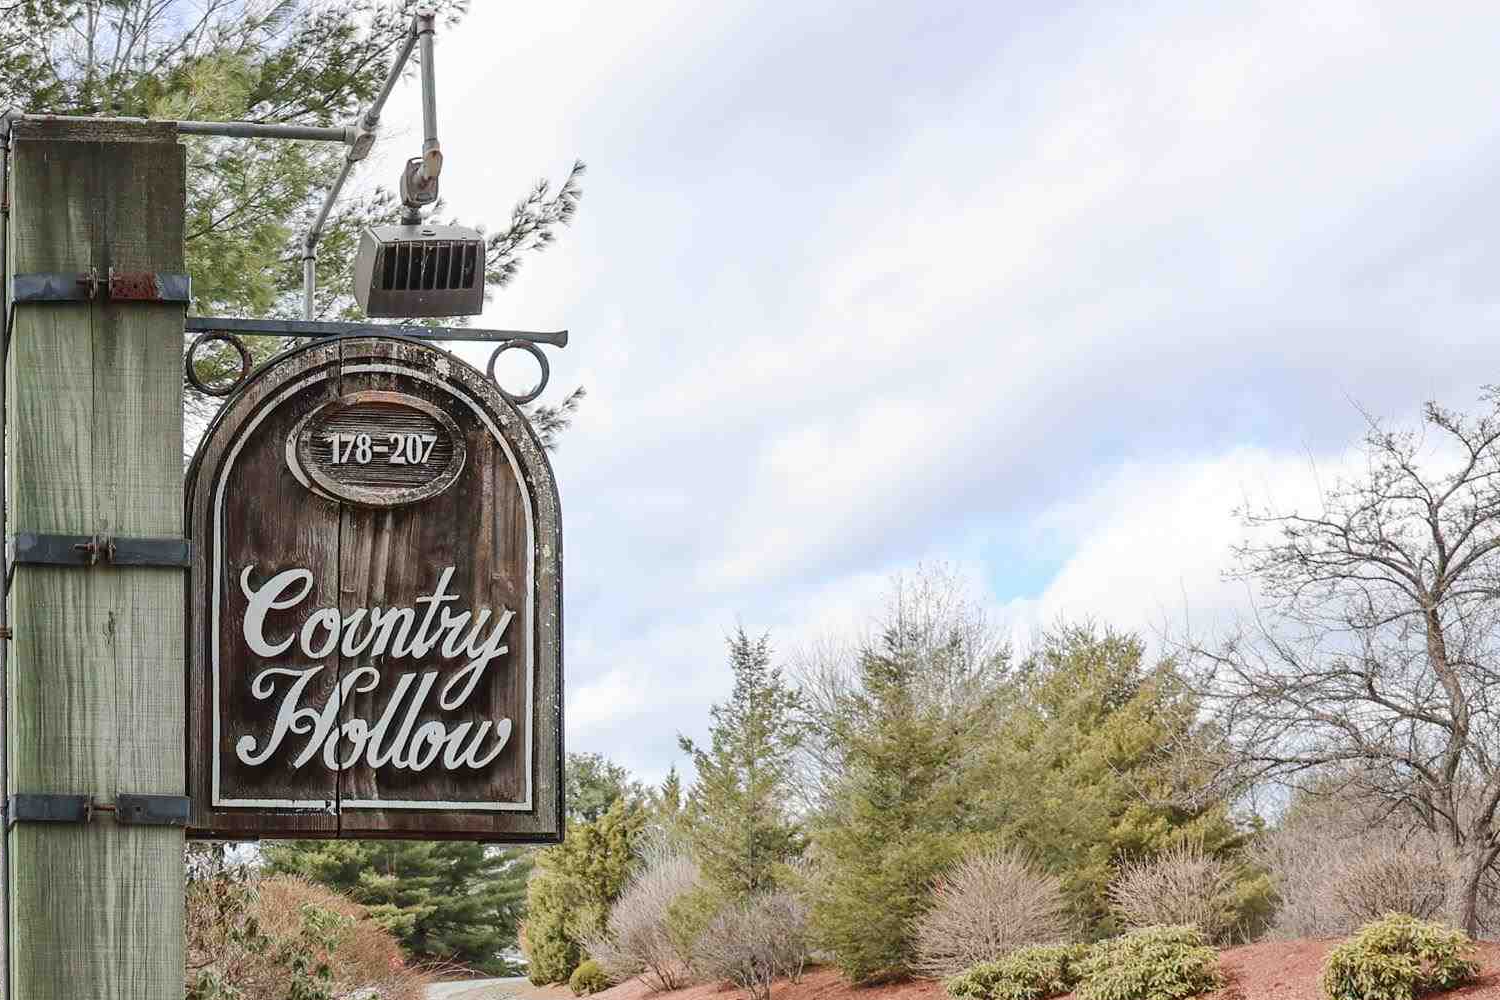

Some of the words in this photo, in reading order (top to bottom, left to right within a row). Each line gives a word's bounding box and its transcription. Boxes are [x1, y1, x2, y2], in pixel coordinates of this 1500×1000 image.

[330, 432, 438, 465] 178-207
[240, 564, 516, 711] Country
[236, 665, 512, 771] Hollow
